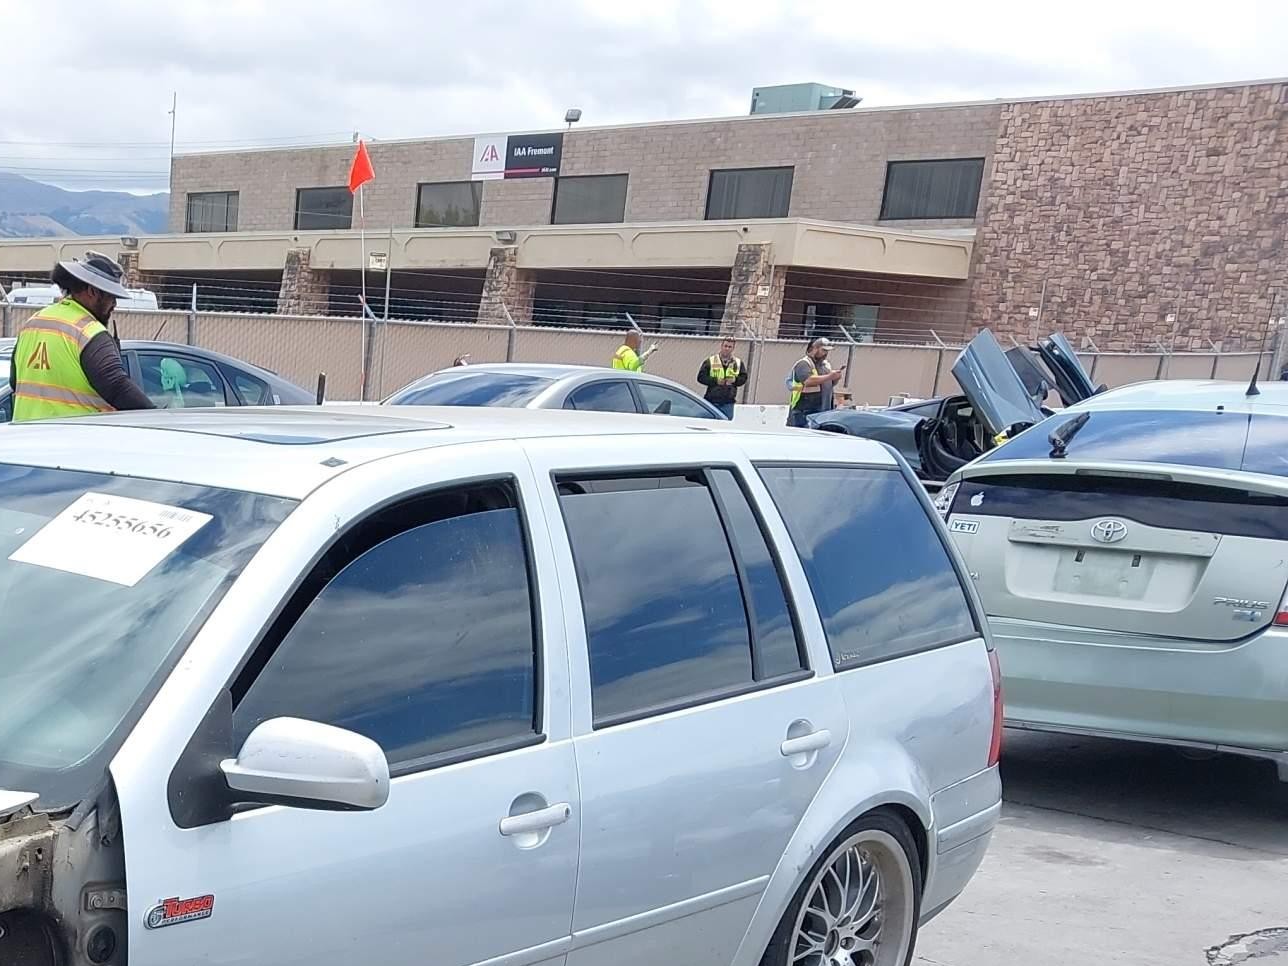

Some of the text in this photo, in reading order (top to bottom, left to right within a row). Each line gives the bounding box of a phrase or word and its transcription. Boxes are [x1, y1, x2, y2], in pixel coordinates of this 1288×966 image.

[514, 145, 554, 157] IAA Fremont
[72, 508, 176, 539] 45255656
[954, 521, 977, 532] YETI
[1213, 596, 1272, 610] PRIUS
[163, 895, 213, 917] TURBO
